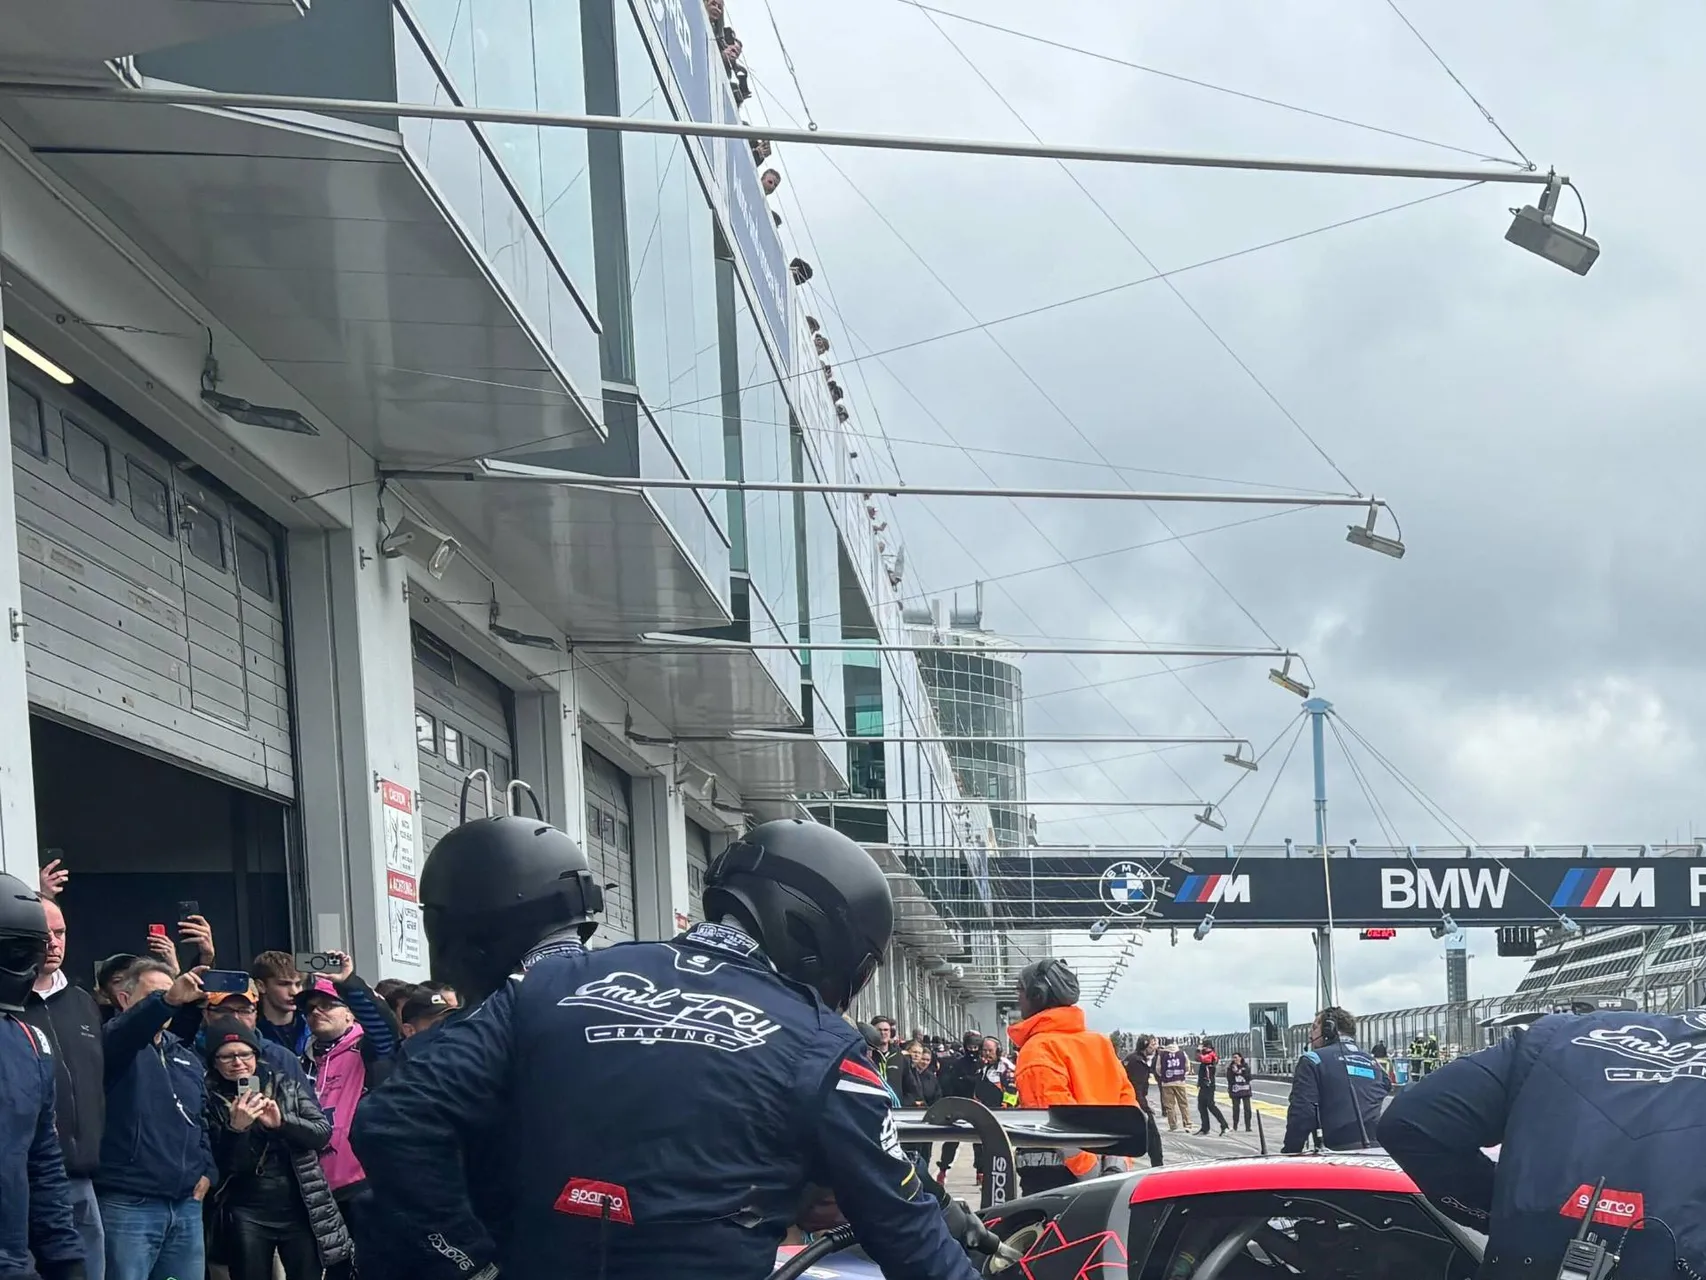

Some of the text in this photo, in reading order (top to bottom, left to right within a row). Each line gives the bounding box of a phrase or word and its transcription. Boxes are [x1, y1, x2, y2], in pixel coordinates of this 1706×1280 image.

[1381, 867, 1510, 909] BMW
[575, 971, 782, 1040] Emil Frey
[616, 1027, 717, 1043] RACING
[1589, 1025, 1692, 1058] Emil
[991, 1154, 1007, 1206] spa
[1578, 1194, 1636, 1216] sarco
